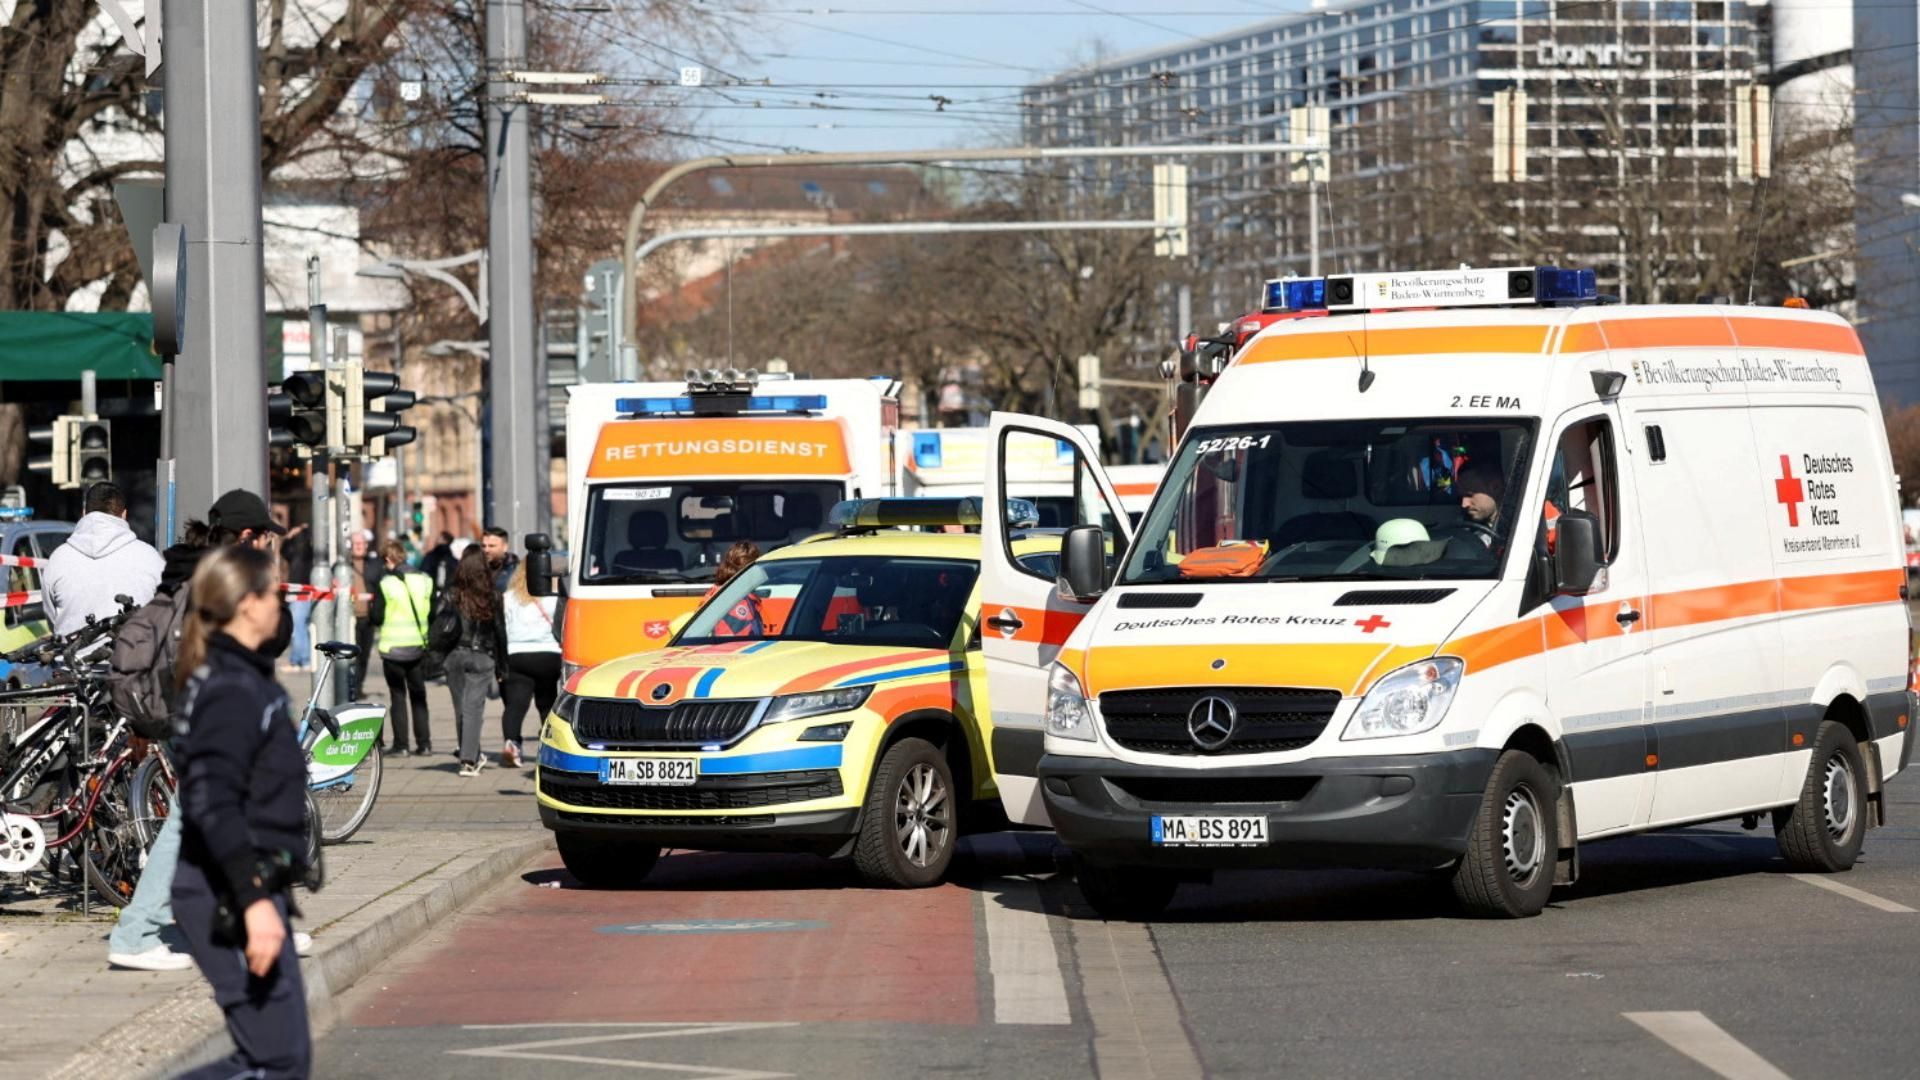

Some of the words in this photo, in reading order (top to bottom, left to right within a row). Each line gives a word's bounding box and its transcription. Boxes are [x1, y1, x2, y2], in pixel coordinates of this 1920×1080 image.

[1641, 358, 1744, 392] Bevölkerungsschutz
[1741, 358, 1841, 391] Baden-Württemberg
[1450, 395, 1463, 408] 2.
[1469, 395, 1492, 408] EE
[1496, 396, 1521, 410] MA
[606, 439, 828, 462] RETTUNGSDIENST
[1196, 435, 1272, 454] 52/26-1
[1803, 453, 1854, 474] Deutsches
[1807, 479, 1836, 500] Rotes
[1811, 505, 1840, 526] Kreuz
[1113, 616, 1217, 632] Deutsches
[1221, 614, 1281, 625] Rotes
[1285, 614, 1347, 626] Kreuz
[352, 728, 375, 740] durch
[326, 744, 339, 756] die
[608, 761, 627, 779] MA
[636, 761, 655, 780] SB
[658, 761, 695, 780] 8821
[1162, 819, 1187, 840] MA
[1199, 819, 1224, 840] BS
[1227, 819, 1265, 840] 891
